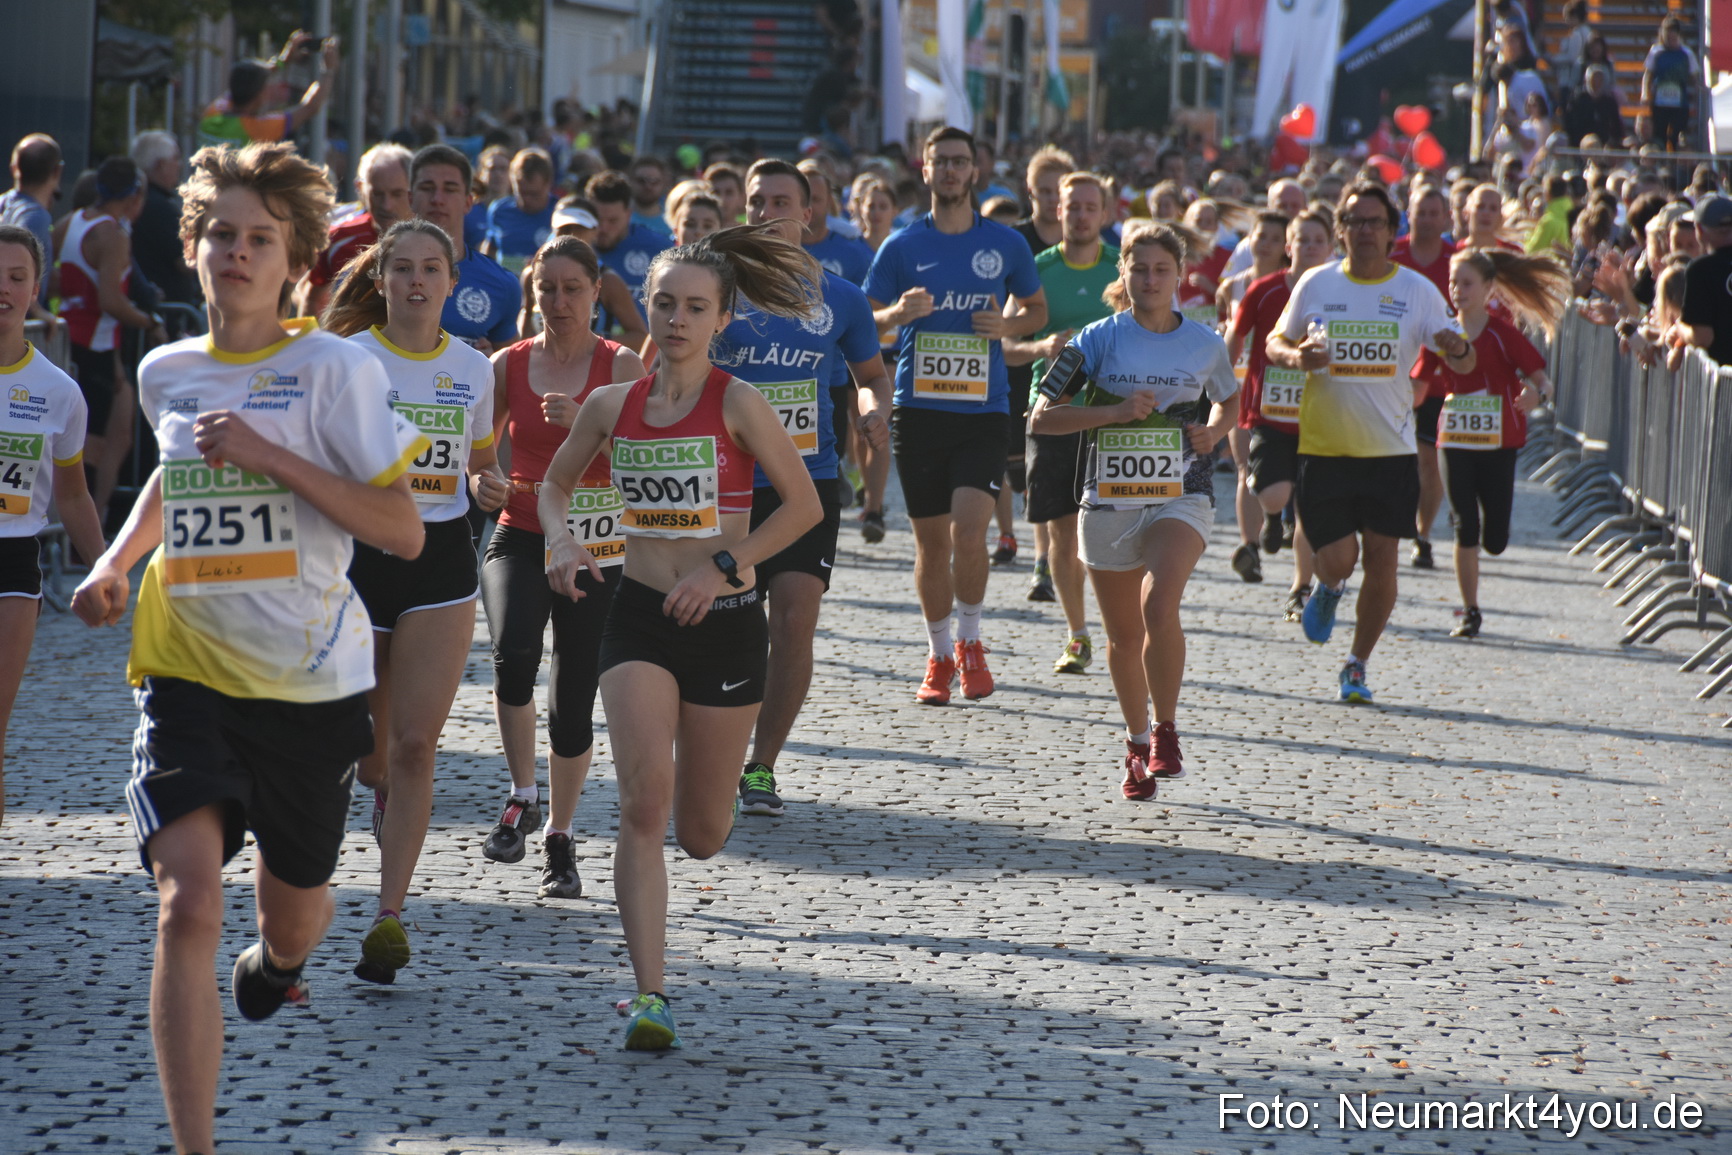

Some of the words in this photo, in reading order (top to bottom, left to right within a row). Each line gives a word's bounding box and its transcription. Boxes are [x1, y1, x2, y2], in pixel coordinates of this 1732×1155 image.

[934, 291, 990, 311] ÄUFT
[1333, 323, 1392, 336] BOCK
[922, 336, 981, 351] BOCK
[1335, 342, 1392, 361] 5060
[736, 342, 824, 370] #LÄUFT
[922, 356, 981, 377] 5078
[1334, 367, 1391, 375] WOLFGANG
[436, 376, 453, 389] 20
[1271, 371, 1306, 380] BOC
[11, 388, 29, 402] 20
[435, 390, 475, 401] Neumarkter
[760, 384, 810, 401] OCK
[933, 382, 968, 392] KEVIN
[1270, 386, 1303, 405] 518
[9, 402, 49, 414] Neumarkter
[9, 411, 41, 423] Stadtlauf
[779, 407, 810, 430] 76
[1446, 413, 1494, 431] 5183
[1104, 432, 1172, 448] BOCK
[412, 440, 451, 469] 03
[618, 442, 705, 466] BOCK
[1106, 456, 1172, 478] 5002
[171, 466, 271, 491] BOCK
[411, 478, 442, 491] ANA
[621, 475, 701, 504] 5001
[1111, 486, 1167, 495] MELANIE
[172, 503, 274, 548] 5251
[588, 543, 625, 557] UELA
[197, 560, 243, 577] Luis
[326, 601, 348, 649] September
